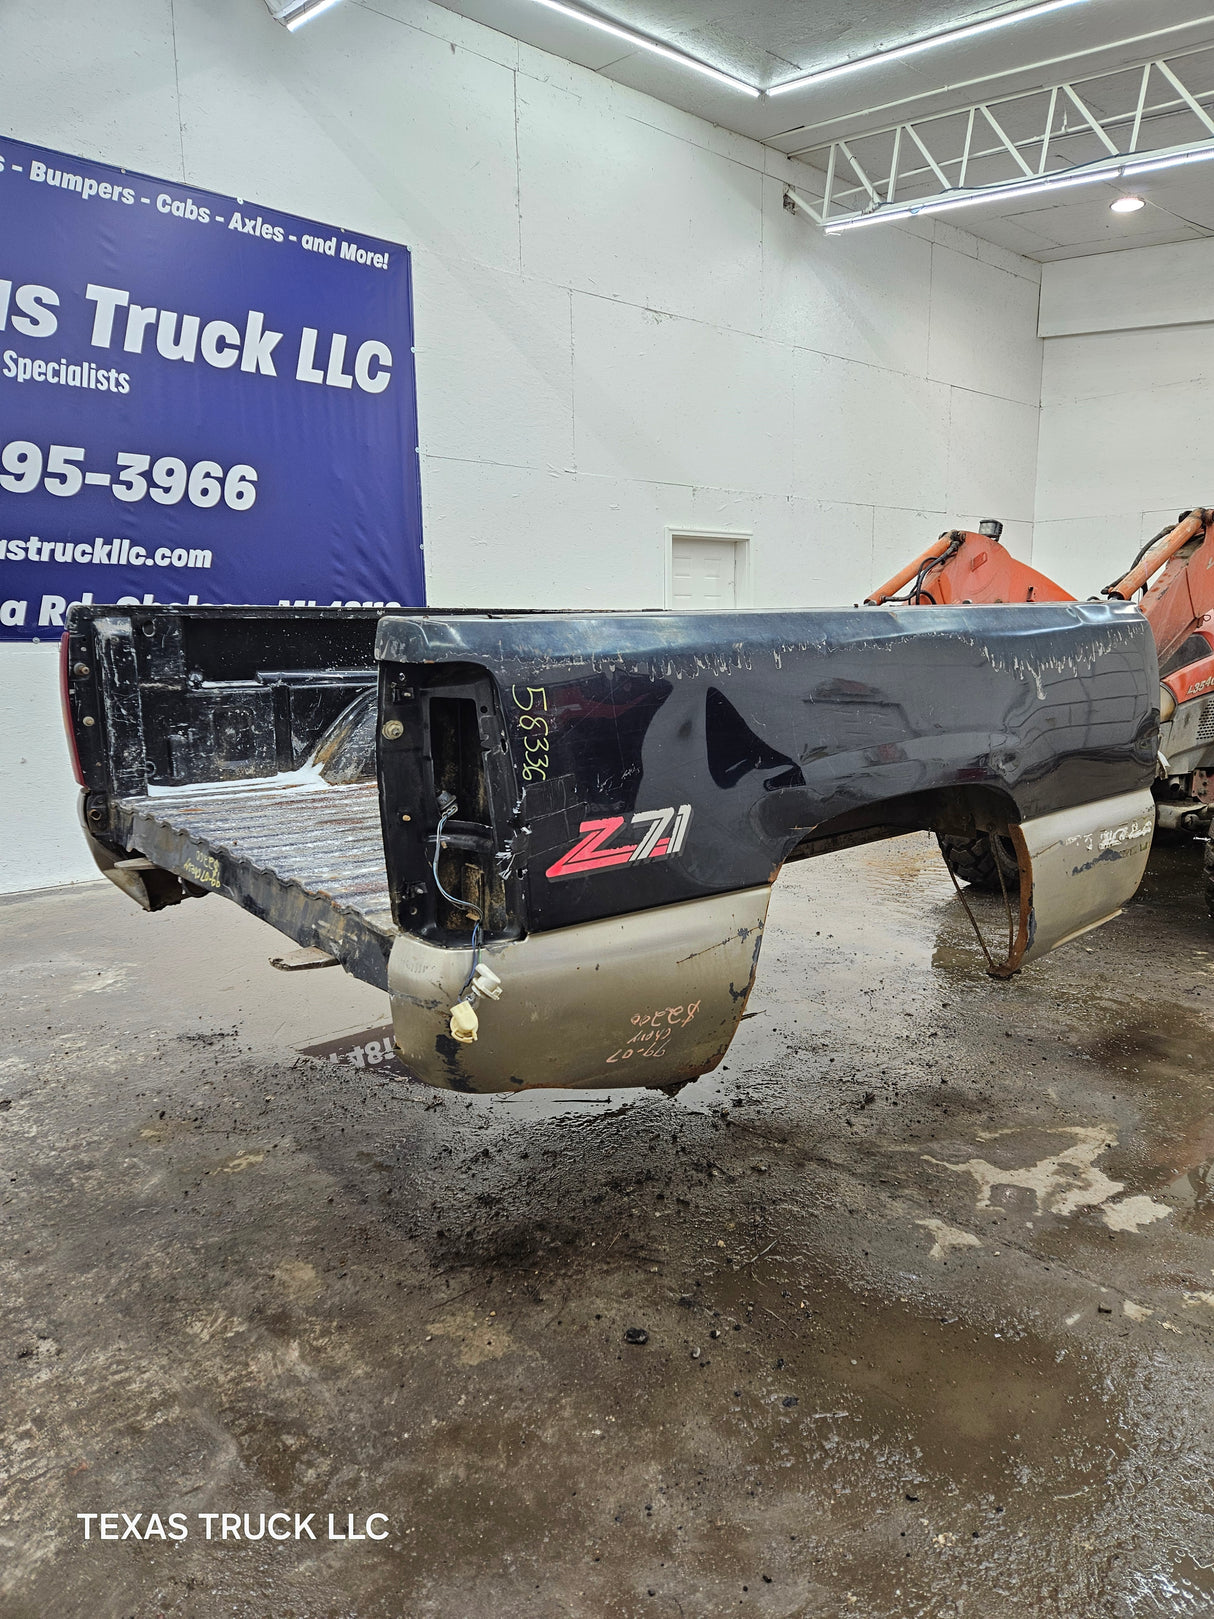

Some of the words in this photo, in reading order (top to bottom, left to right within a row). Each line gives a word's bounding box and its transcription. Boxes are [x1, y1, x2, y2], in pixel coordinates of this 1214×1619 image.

[29, 160, 136, 206] Bumpers
[156, 193, 211, 224] Cabs
[227, 211, 285, 243] Axles
[301, 234, 337, 257] and
[339, 242, 389, 270] More!
[2, 349, 131, 394] Specialists
[86, 283, 284, 377] Truck
[295, 326, 393, 394] LLC
[0, 440, 258, 511] 95-3966
[511, 684, 550, 781] 58336
[545, 804, 694, 880] Z71
